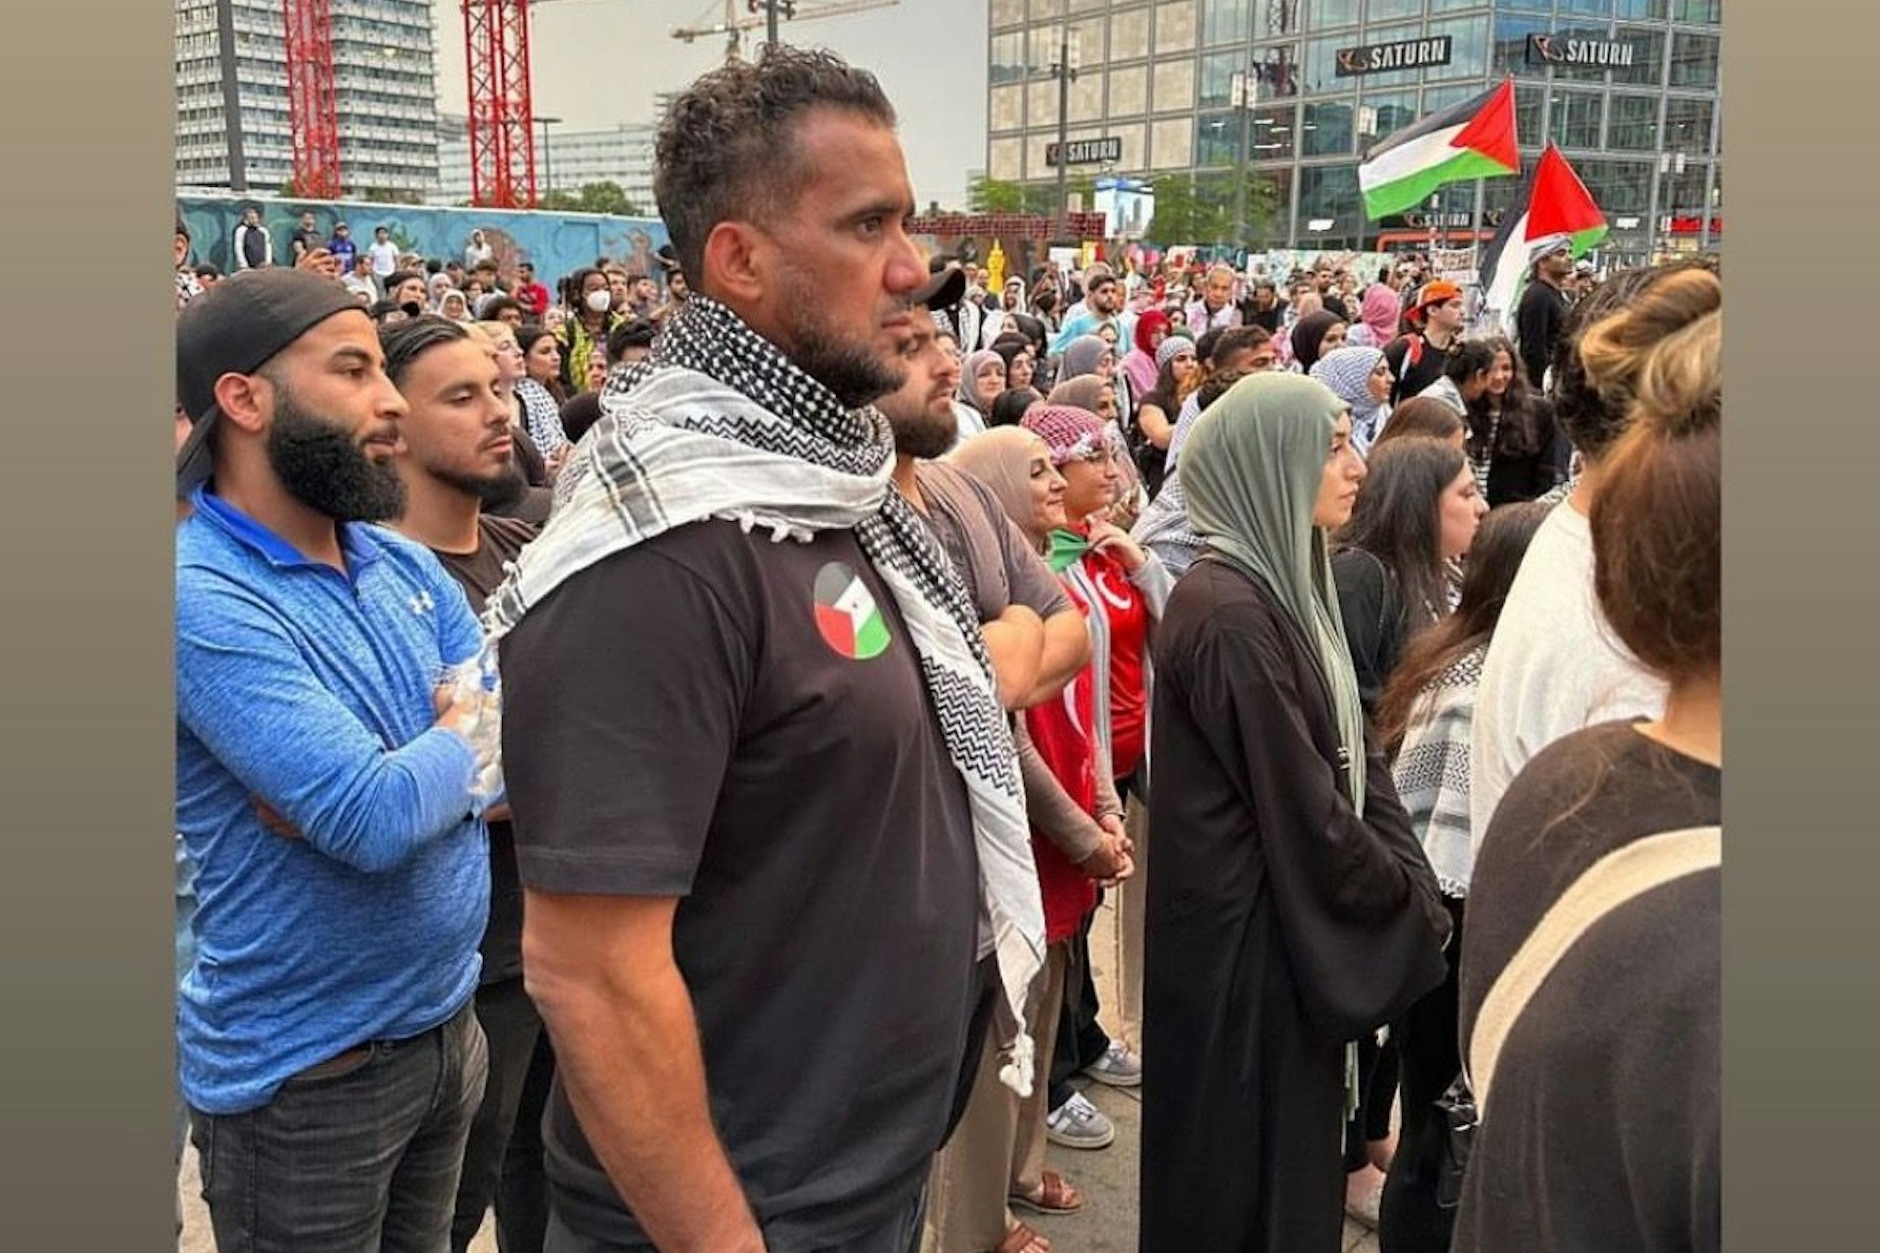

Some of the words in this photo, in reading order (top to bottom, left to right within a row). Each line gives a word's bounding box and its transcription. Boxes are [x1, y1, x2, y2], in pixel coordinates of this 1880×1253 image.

[1371, 39, 1446, 69] SATURN
[1566, 39, 1633, 65] SATURN
[1068, 139, 1117, 162] SATURN
